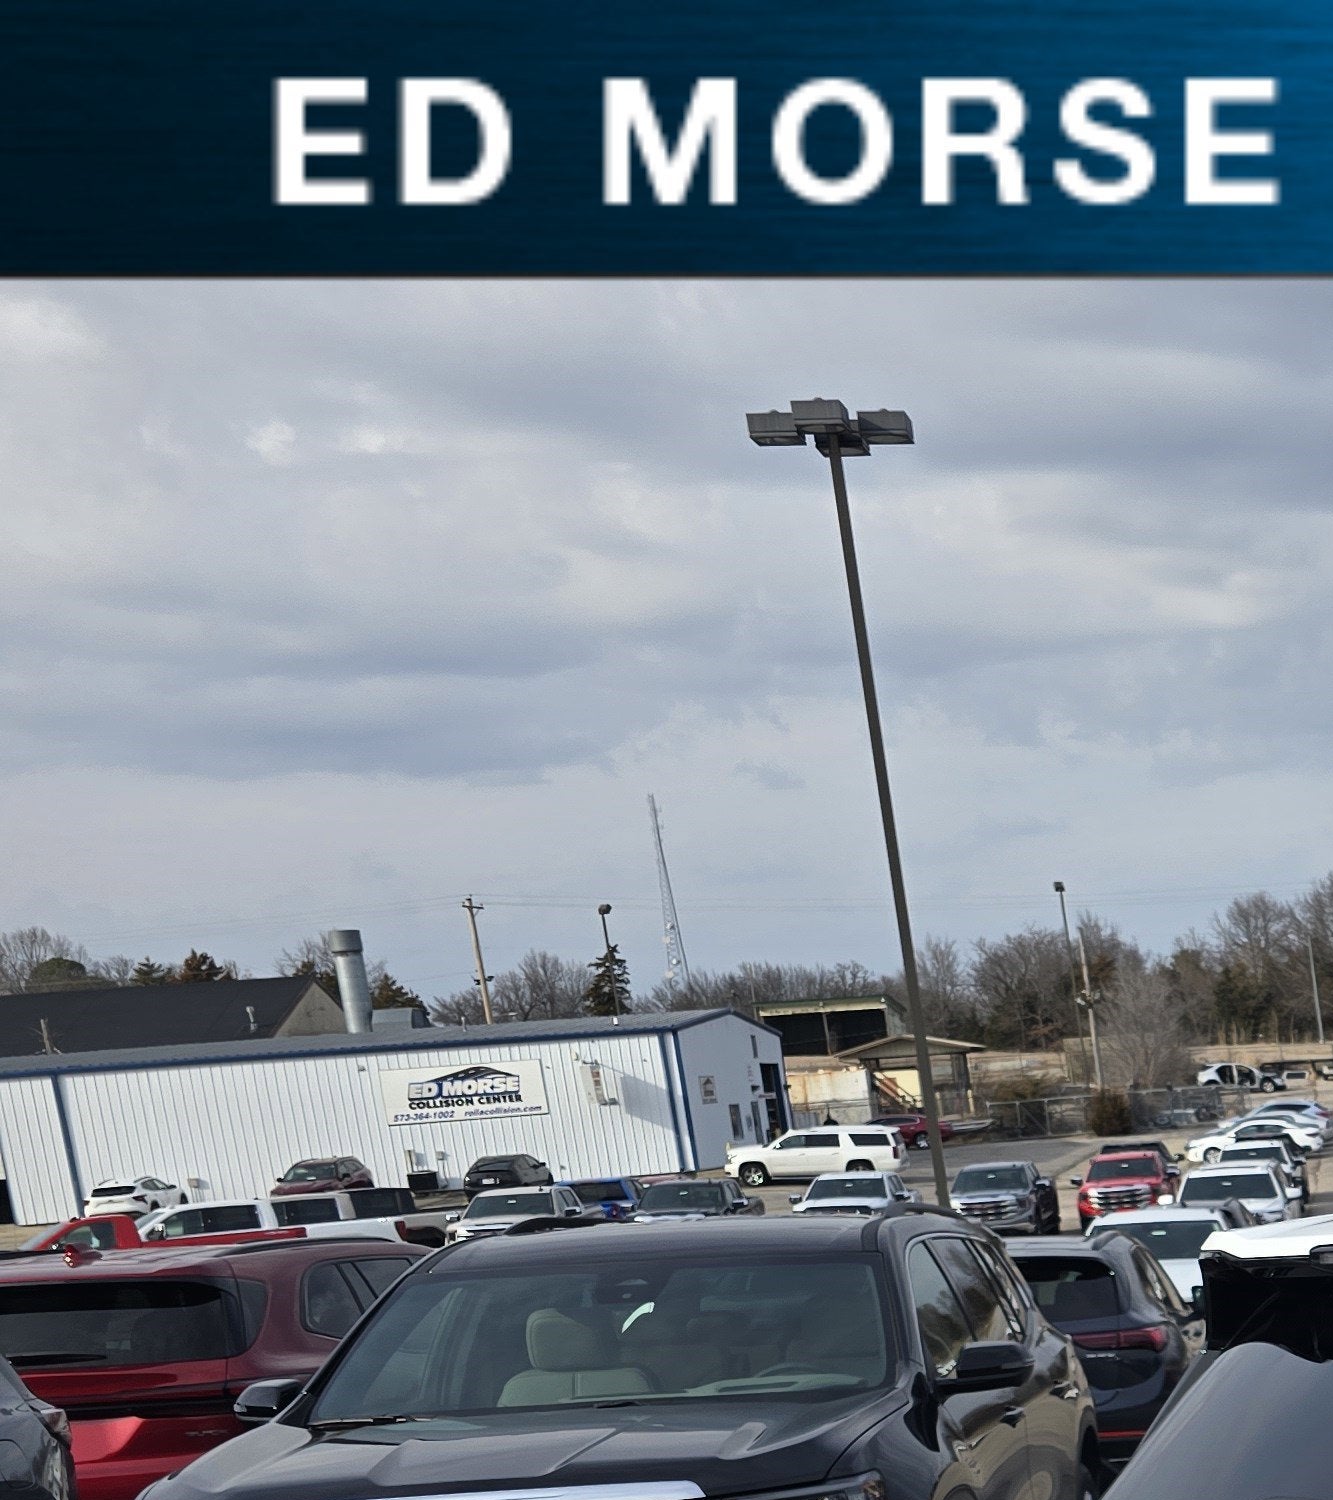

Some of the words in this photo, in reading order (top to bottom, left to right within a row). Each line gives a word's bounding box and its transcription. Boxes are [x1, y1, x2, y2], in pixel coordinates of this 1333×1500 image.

[408, 1082, 438, 1100] ED
[441, 1075, 519, 1098] MORSE
[409, 1098, 474, 1110] COLLISION
[478, 1094, 523, 1105] CENTER
[394, 1110, 455, 1122] 573-364-1002
